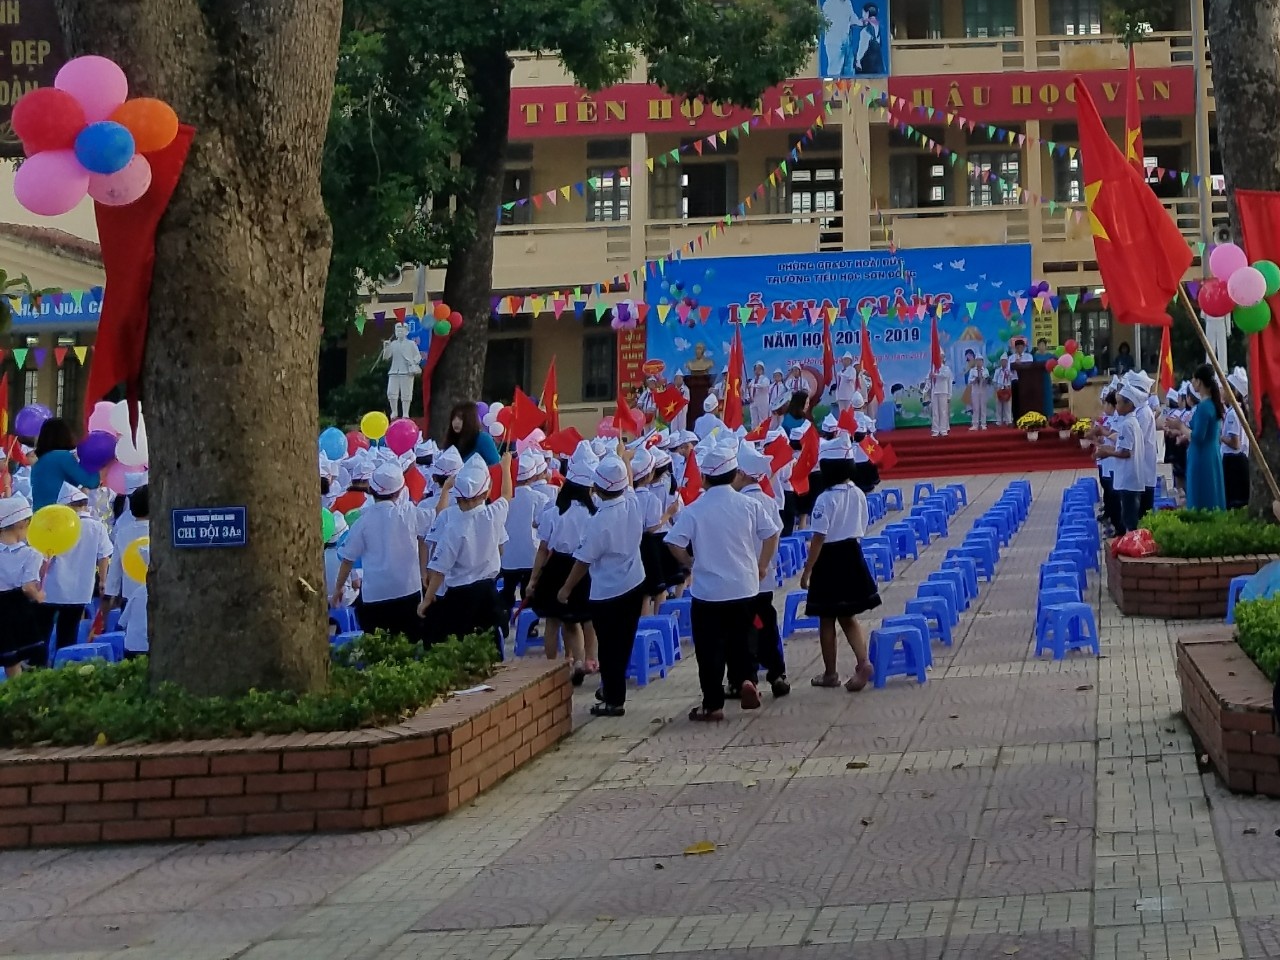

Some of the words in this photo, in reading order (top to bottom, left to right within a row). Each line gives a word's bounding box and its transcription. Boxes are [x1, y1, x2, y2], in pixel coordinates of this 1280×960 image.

[763, 330, 800, 350] NĂM
[801, 332, 825, 350] HỌ
[835, 329, 871, 347] 201
[885, 326, 921, 344] 2019
[177, 527, 196, 539] CHI
